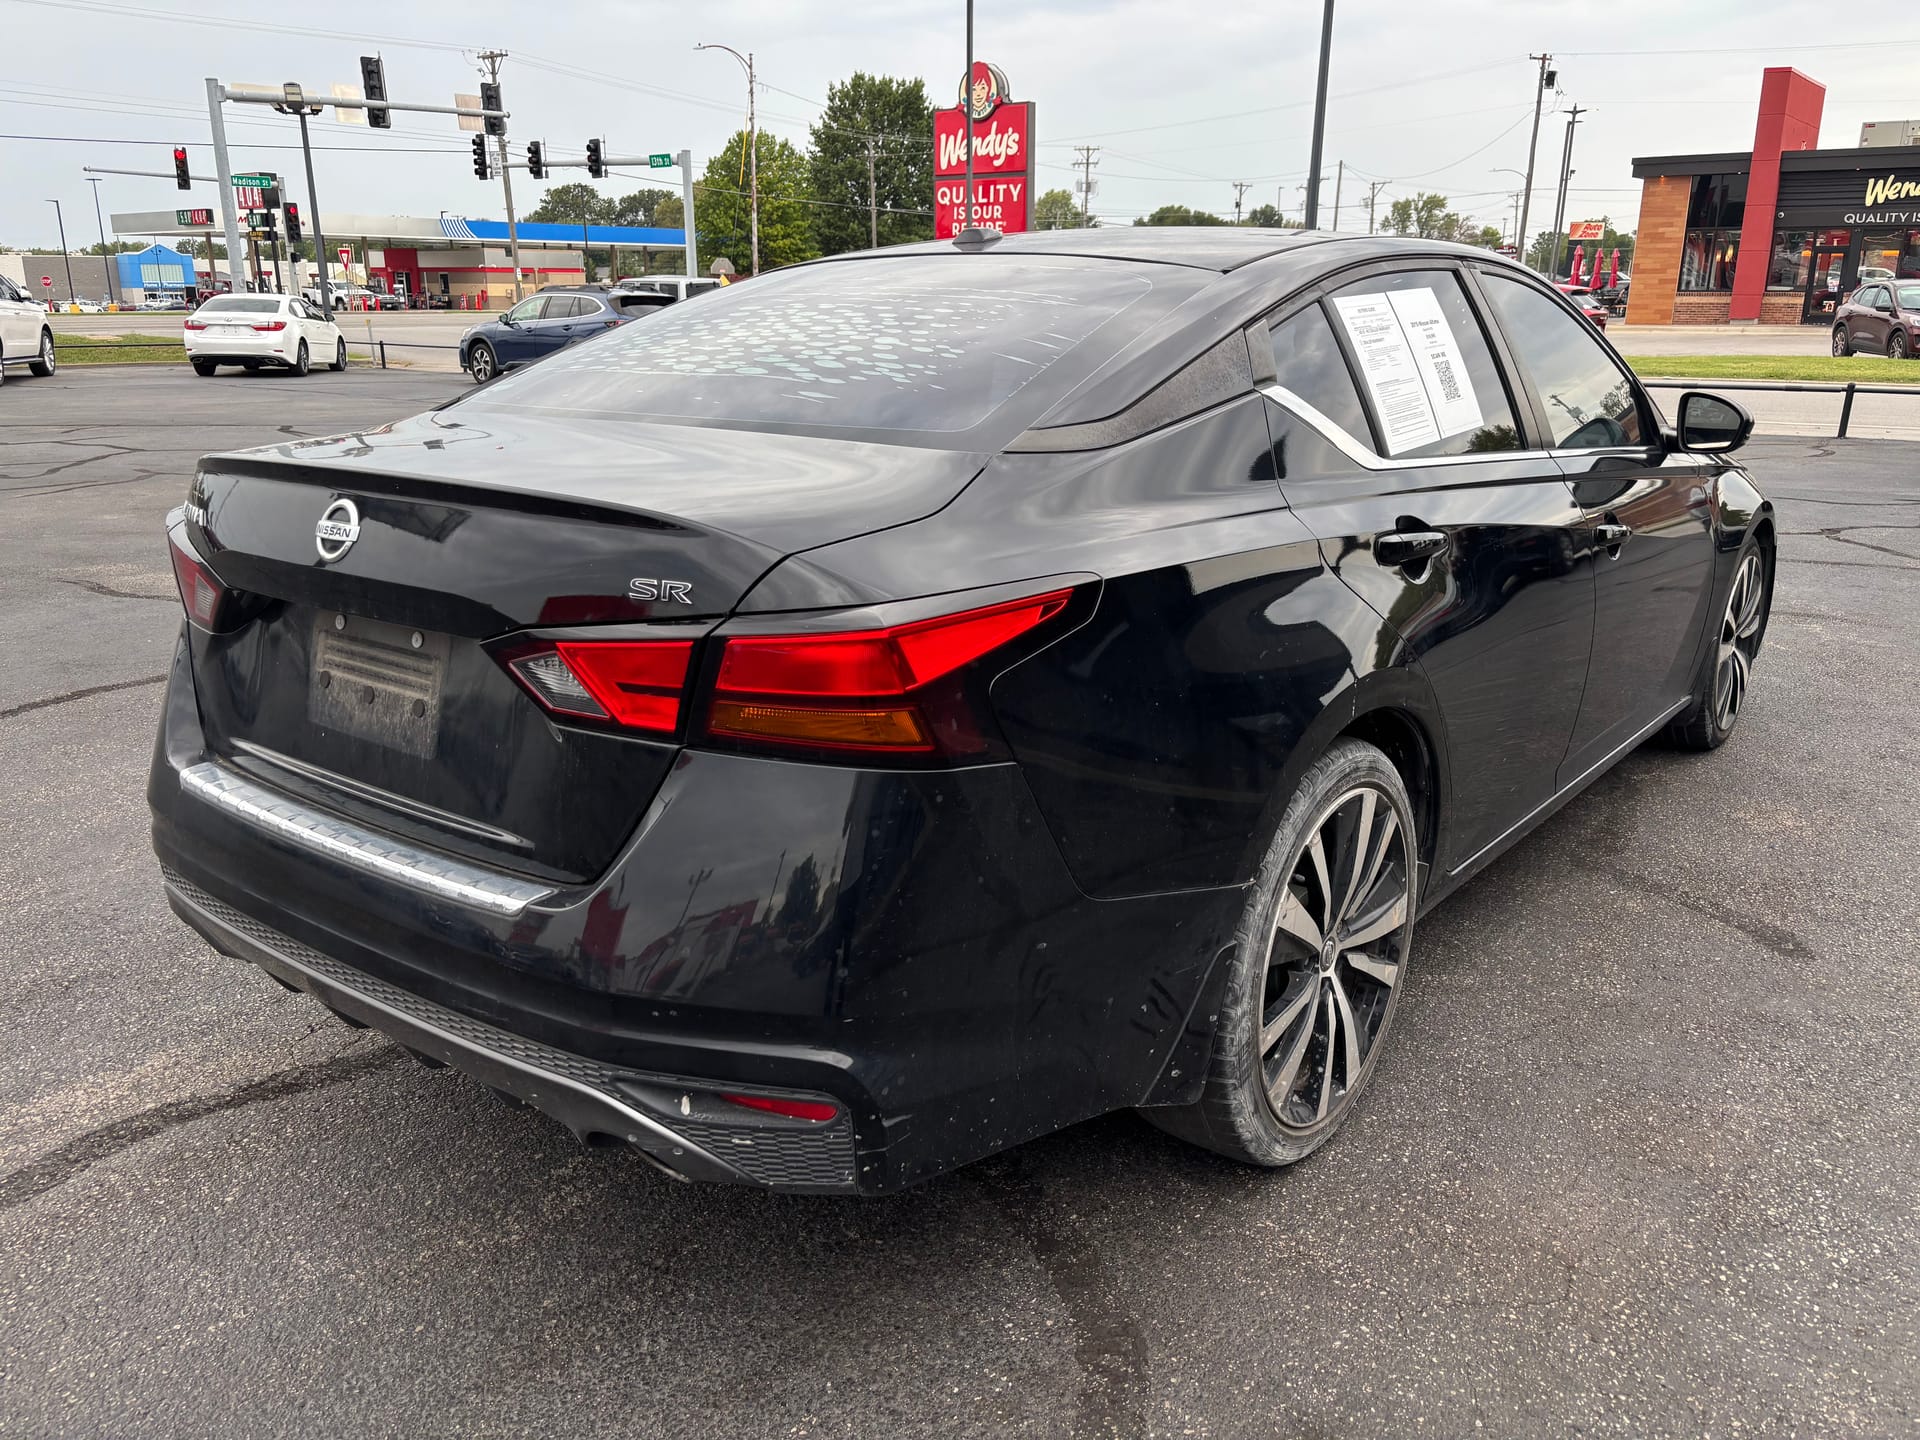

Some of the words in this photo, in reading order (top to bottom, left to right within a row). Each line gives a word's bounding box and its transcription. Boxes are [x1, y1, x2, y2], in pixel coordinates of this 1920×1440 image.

[940, 121, 1019, 170] Wendy's
[651, 157, 664, 166] 13th
[232, 177, 260, 186] Madison
[1865, 174, 1920, 206] Wen
[953, 206, 966, 220] IS
[971, 205, 1002, 220] OUR
[1844, 212, 1909, 224] QUALITY
[1583, 223, 1603, 231] Auto
[316, 524, 352, 539] NISSAN
[628, 577, 693, 605] SR
